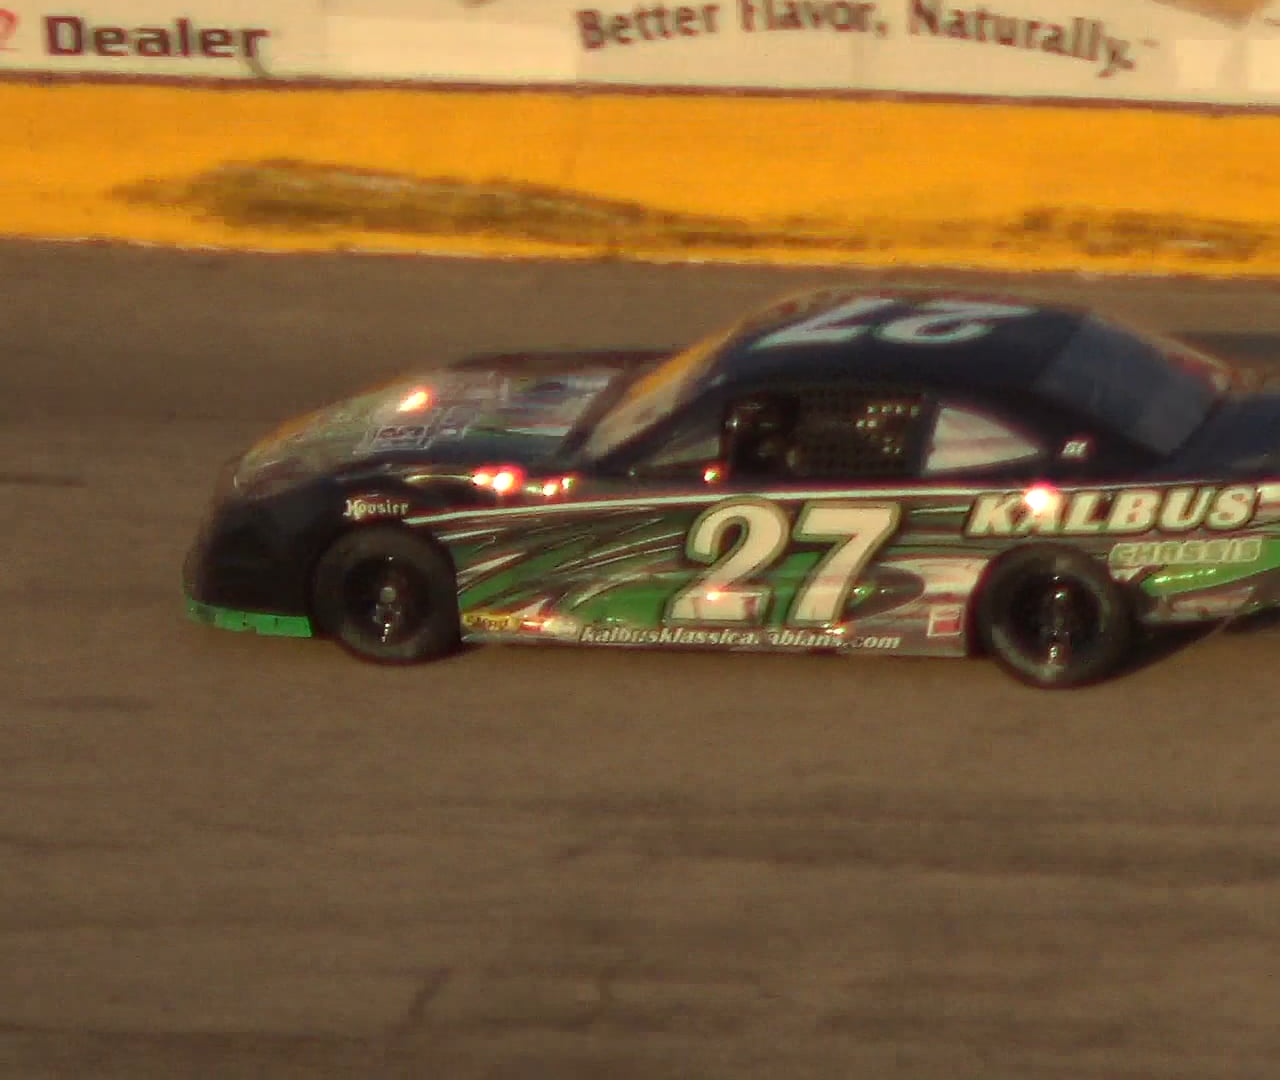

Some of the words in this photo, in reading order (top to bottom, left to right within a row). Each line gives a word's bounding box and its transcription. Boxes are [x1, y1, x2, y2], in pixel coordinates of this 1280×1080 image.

[45, 15, 271, 58] Dealer
[576, 2, 721, 51] Better
[342, 498, 410, 521] Hoosier
[966, 485, 1259, 537] KALBUS
[666, 498, 899, 625] 27
